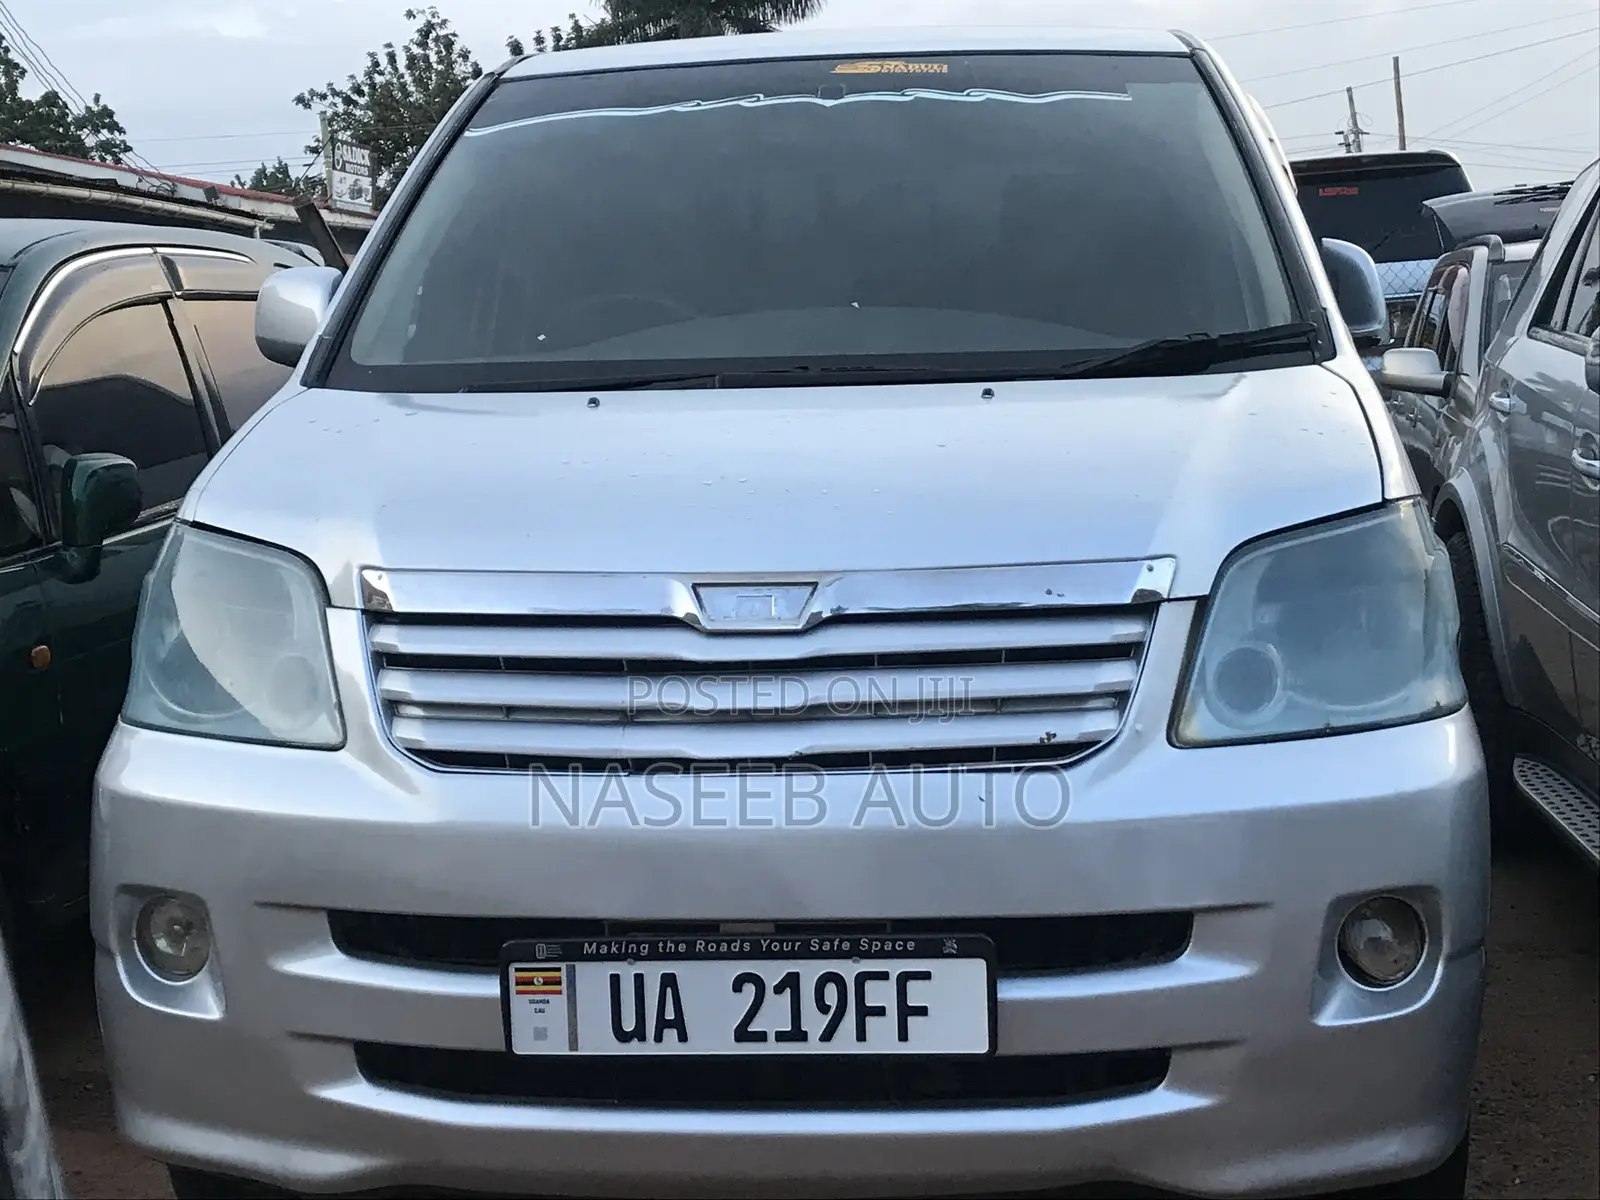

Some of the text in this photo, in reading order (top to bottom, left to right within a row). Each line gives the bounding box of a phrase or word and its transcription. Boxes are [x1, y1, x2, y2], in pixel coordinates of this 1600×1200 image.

[345, 163, 368, 176] MOTORS
[583, 938, 916, 956] Making the Roads Your Safe Space
[609, 970, 932, 1042] UA 219FF
